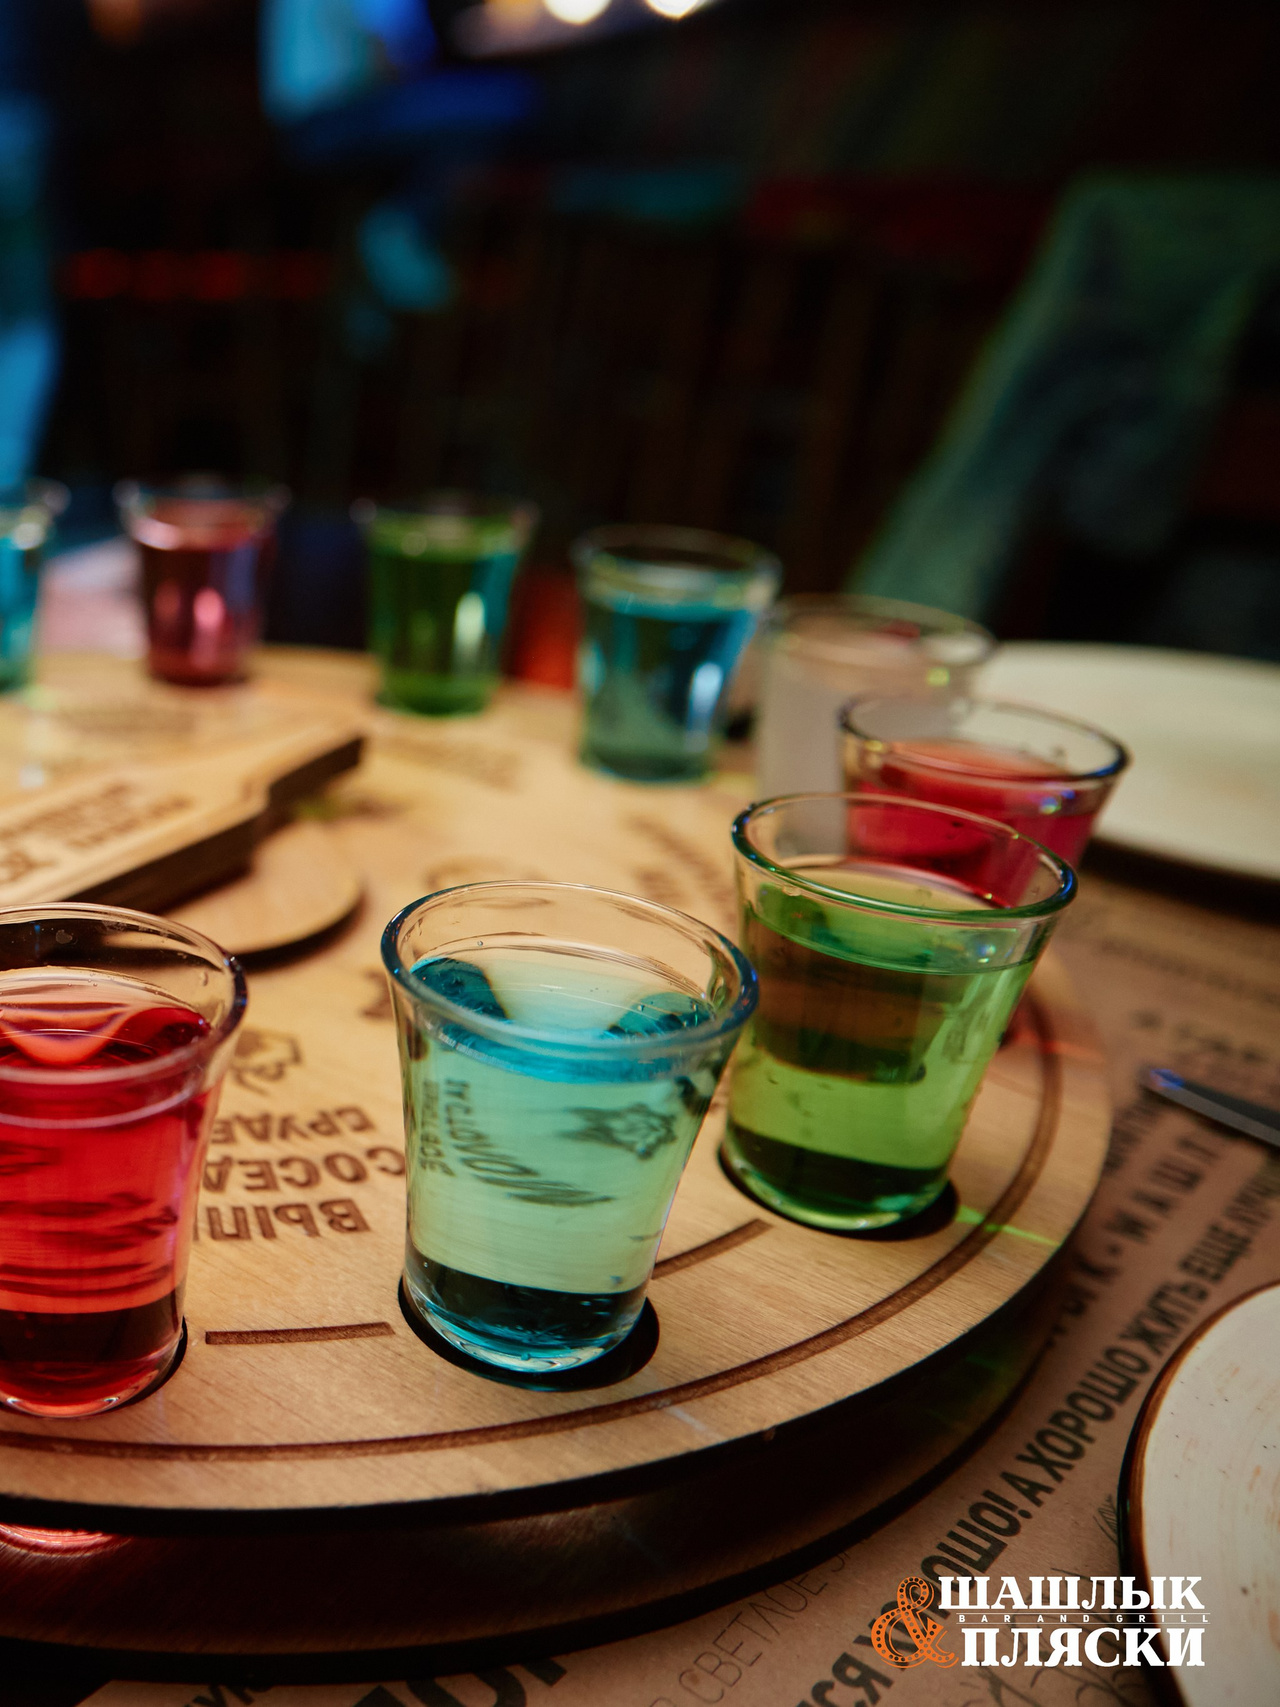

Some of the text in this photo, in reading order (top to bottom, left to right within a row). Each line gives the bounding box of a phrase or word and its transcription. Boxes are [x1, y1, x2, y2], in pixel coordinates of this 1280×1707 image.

[192, 1199, 371, 1242] ВЫП
[1119, 1282, 1208, 1356] ЖИТЬ
[1015, 1346, 1151, 1484] ХОРОШО
[1000, 1471, 1055, 1508] А
